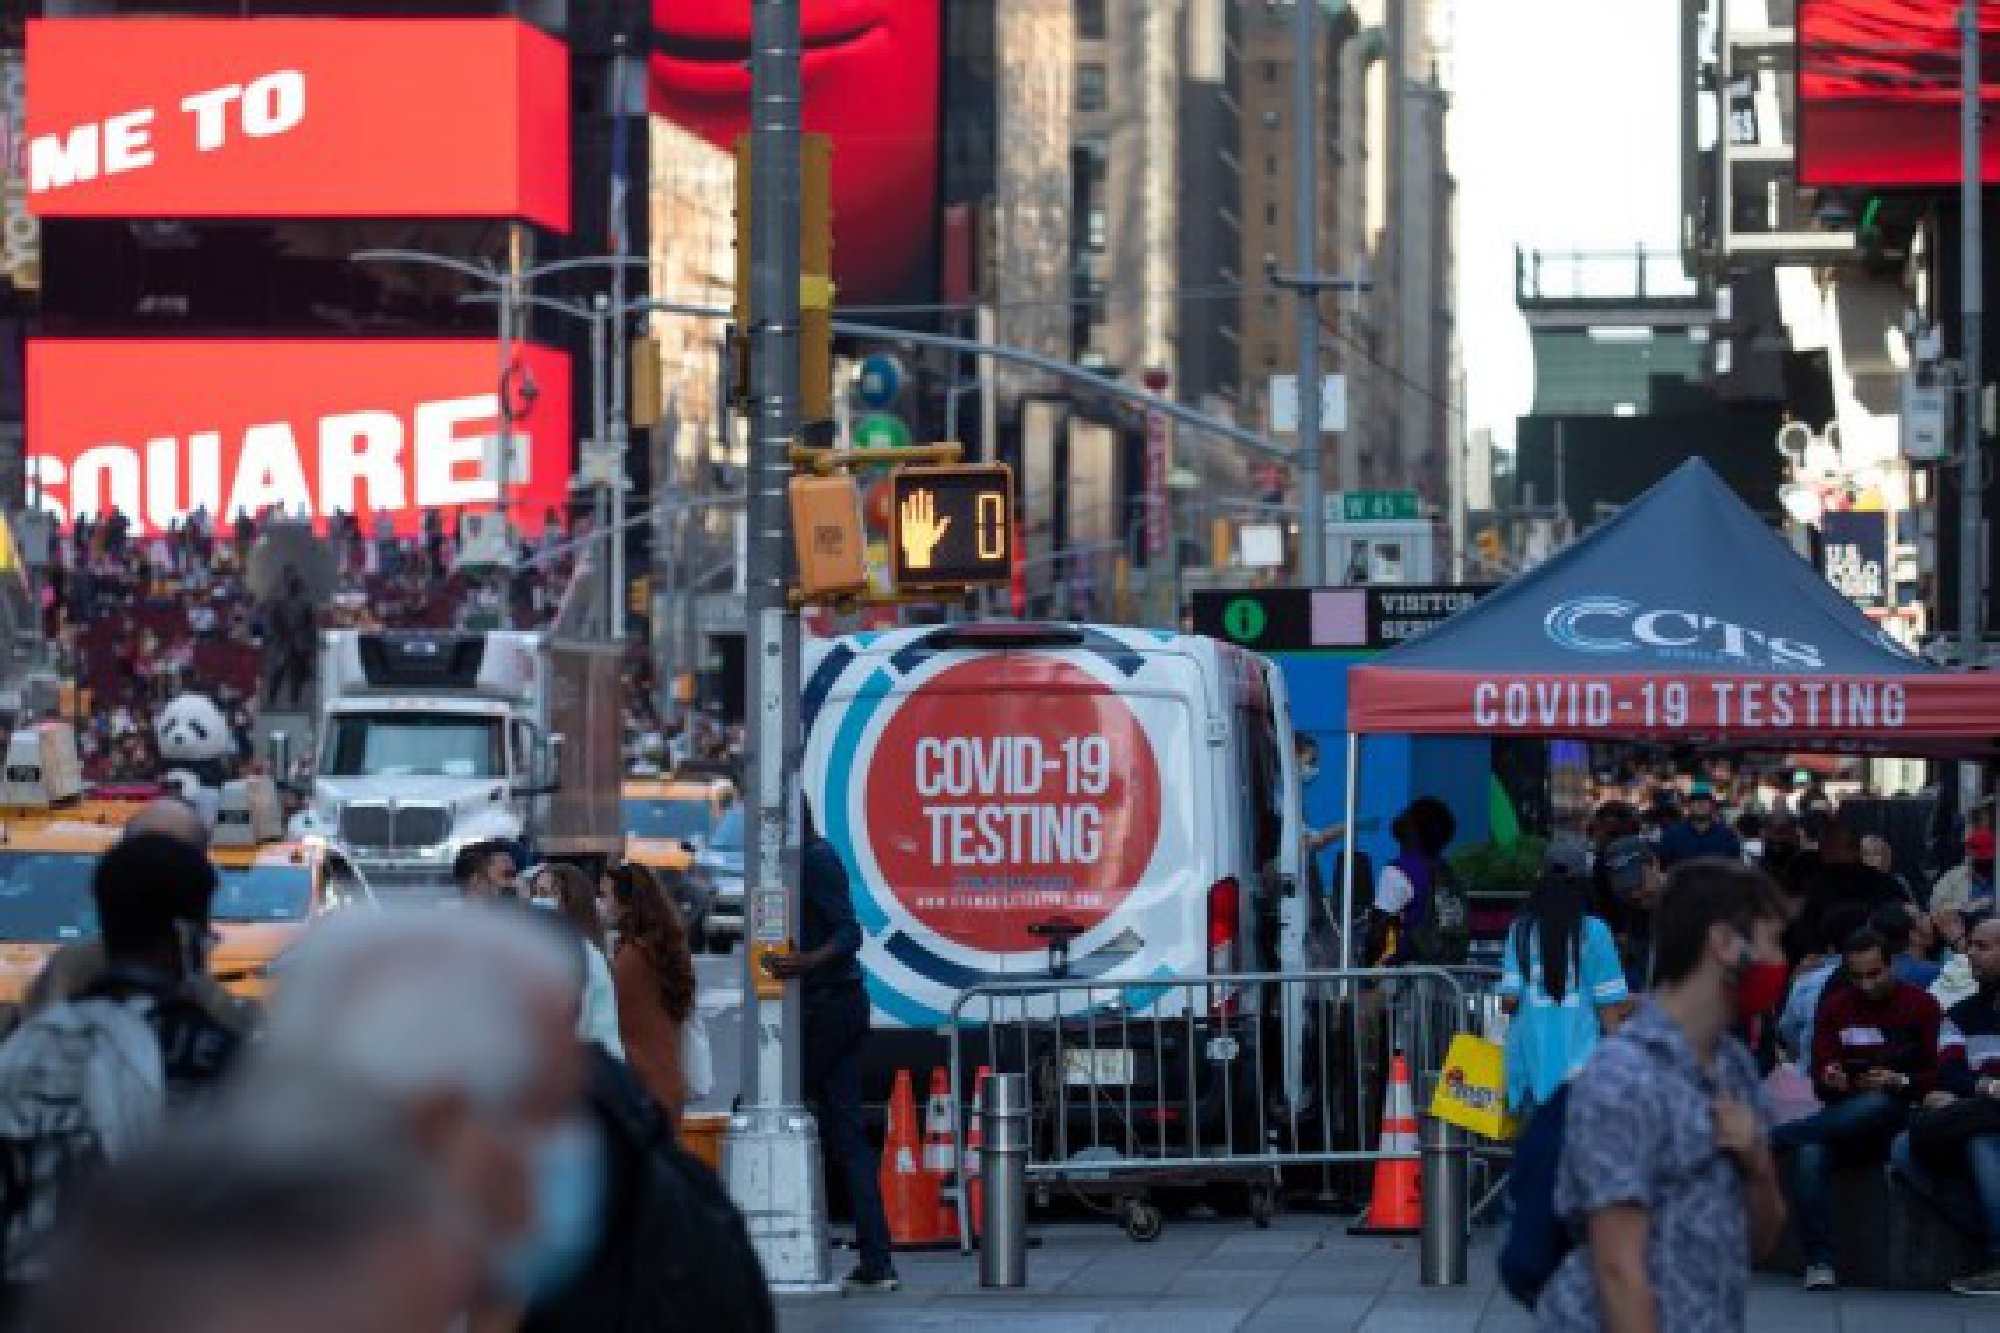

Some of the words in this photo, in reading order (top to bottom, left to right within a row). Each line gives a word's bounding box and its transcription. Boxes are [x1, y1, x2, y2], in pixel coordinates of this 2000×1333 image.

[30, 108, 155, 193] ME
[181, 69, 306, 153] TO
[27, 394, 502, 537] SQUARE
[1349, 496, 1366, 517] W
[1371, 495, 1395, 517] 45
[1473, 681, 1690, 728] COVID-19
[1711, 681, 1906, 728] TESTING
[915, 735, 1111, 796] COVID-19
[922, 804, 1101, 867] TESTING
